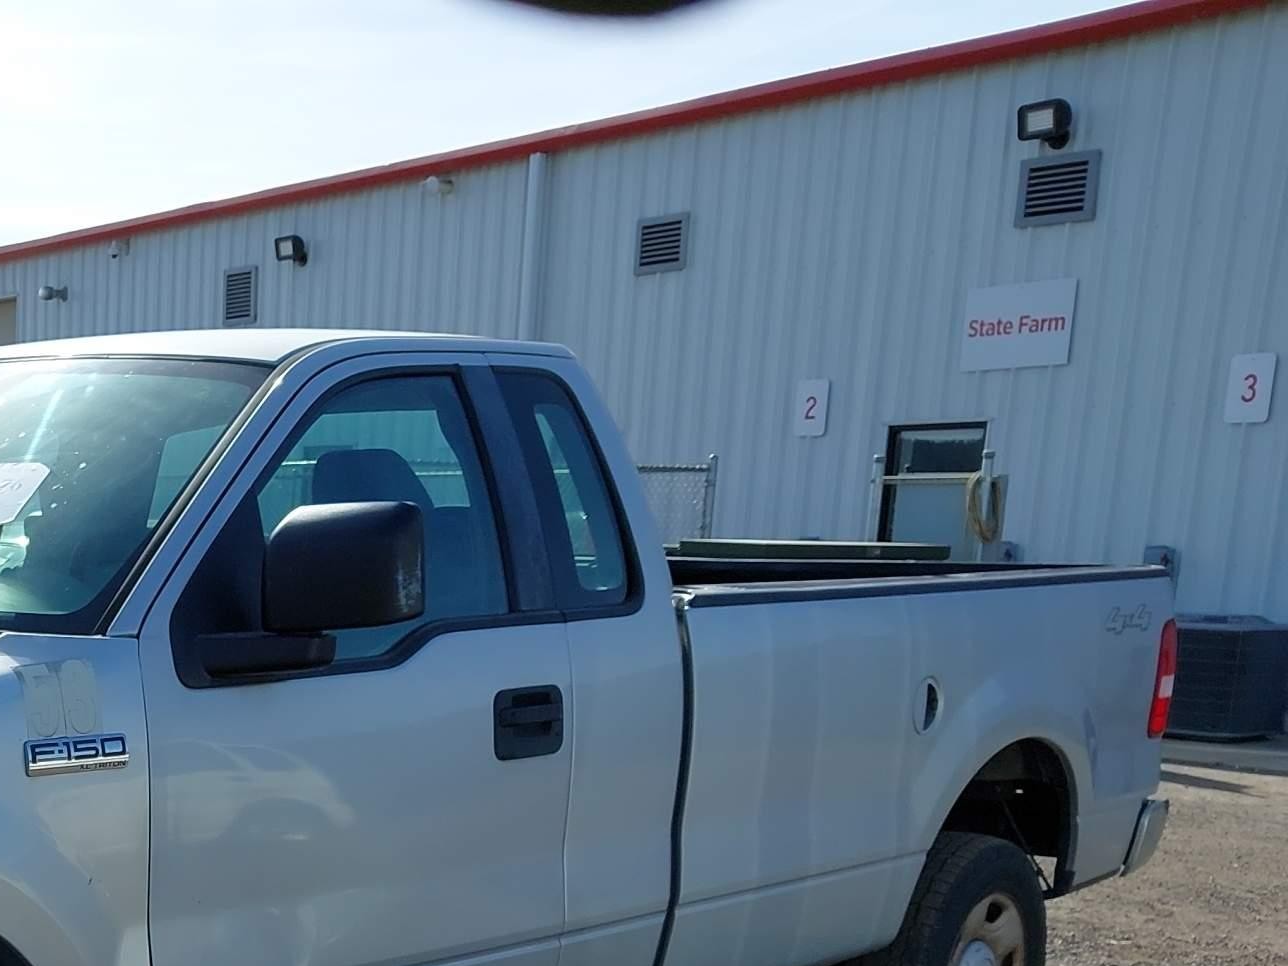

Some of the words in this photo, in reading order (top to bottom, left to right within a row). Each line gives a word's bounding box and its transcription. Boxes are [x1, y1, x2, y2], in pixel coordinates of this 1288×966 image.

[967, 317, 1014, 338] State
[1018, 313, 1066, 335] Farm
[1240, 373, 1258, 403] 3
[804, 396, 818, 420] 2
[29, 736, 127, 764] F-150
